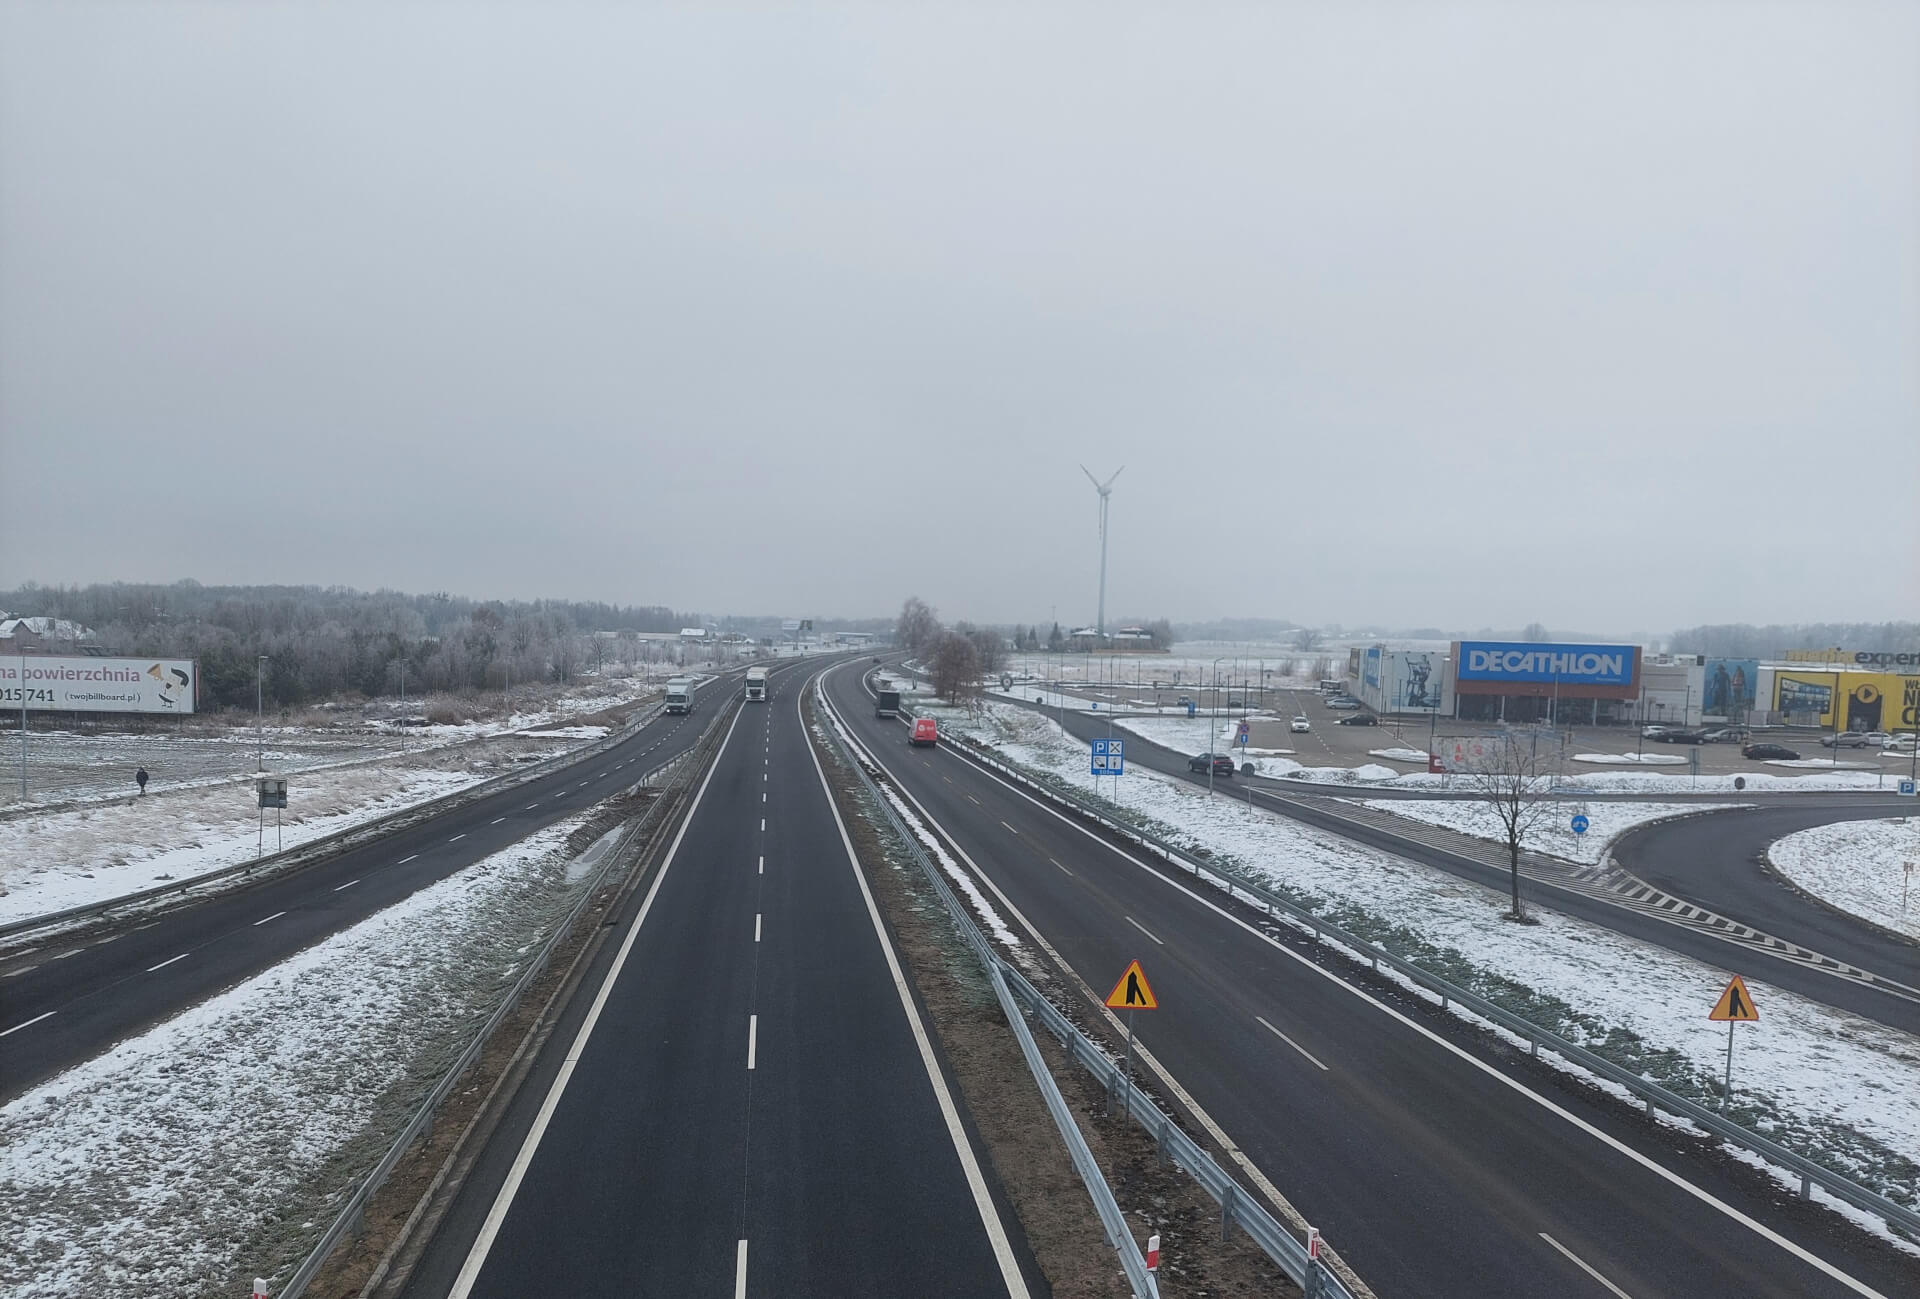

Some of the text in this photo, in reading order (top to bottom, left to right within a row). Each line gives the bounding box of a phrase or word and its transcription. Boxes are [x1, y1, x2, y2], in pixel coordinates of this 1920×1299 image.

[1469, 650, 1622, 675] DECATHLON
[22, 666, 141, 682] powierzchnia
[26, 688, 55, 702] 741
[1097, 743, 1104, 752] P
[1904, 783, 1912, 792] P
